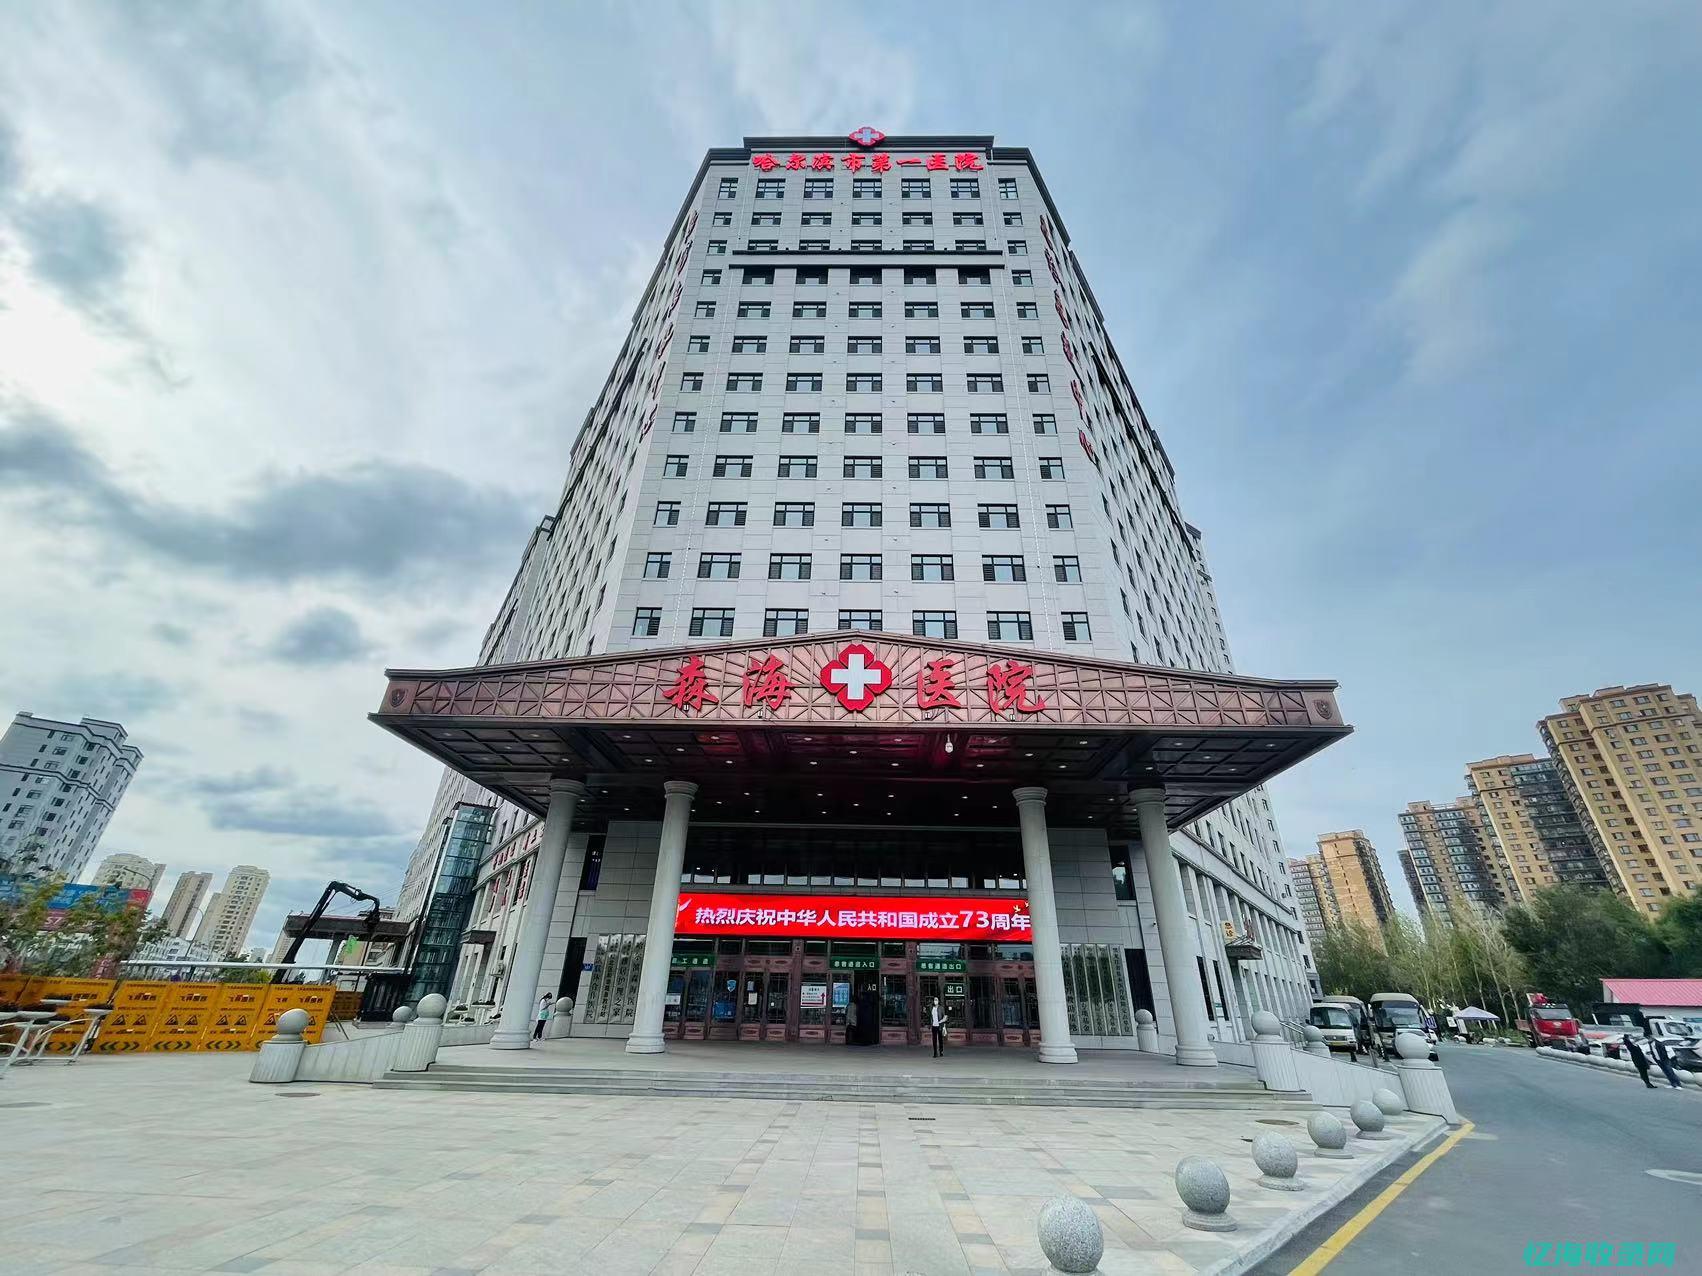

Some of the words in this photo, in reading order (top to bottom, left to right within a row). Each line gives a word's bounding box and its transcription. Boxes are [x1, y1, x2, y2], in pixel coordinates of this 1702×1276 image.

[752, 152, 984, 173] 哈尔滨市第一医院
[662, 656, 1046, 714] 森海医院
[695, 907, 1032, 931] 热烈庆祝中华人民共和国成立73周年
[947, 985, 963, 993] 出口
